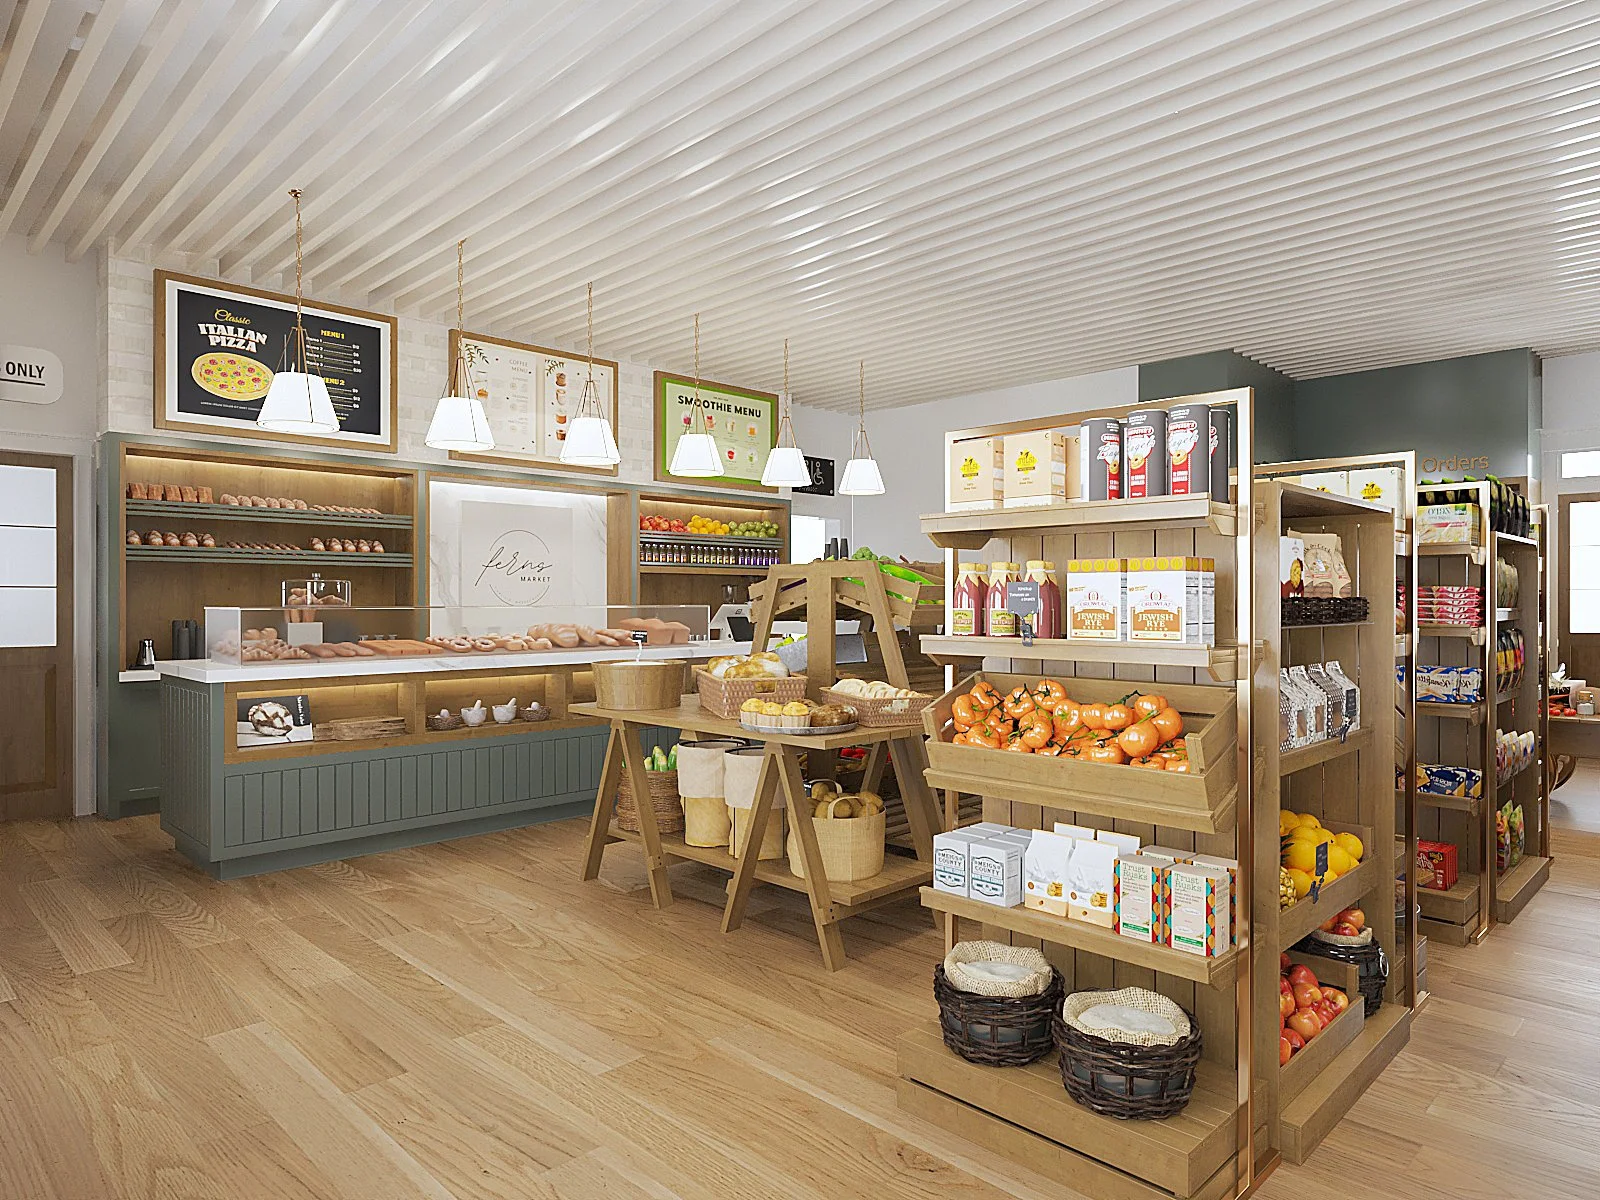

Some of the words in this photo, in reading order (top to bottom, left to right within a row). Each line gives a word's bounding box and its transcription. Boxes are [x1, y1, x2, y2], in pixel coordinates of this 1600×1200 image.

[214, 308, 252, 325] Classic
[197, 323, 268, 345] ITALIAN
[320, 329, 340, 339] MENU
[208, 335, 257, 353] PIZZA
[508, 359, 528, 368] COFFEE
[5, 361, 45, 379] ONLY
[511, 366, 528, 374] MENU
[677, 395, 732, 413] SMOOTHIE
[734, 405, 762, 418] MENU
[1421, 455, 1490, 474] Orders
[1077, 612, 1110, 621] JEWISH
[1137, 613, 1174, 622] JEWISH
[1084, 619, 1102, 627] RYE
[1146, 620, 1166, 628] RYE
[941, 852, 959, 861] MEIGS
[938, 857, 961, 867] COUNTY
[977, 860, 996, 869] MEIGS
[974, 865, 1000, 876] COUNTY
